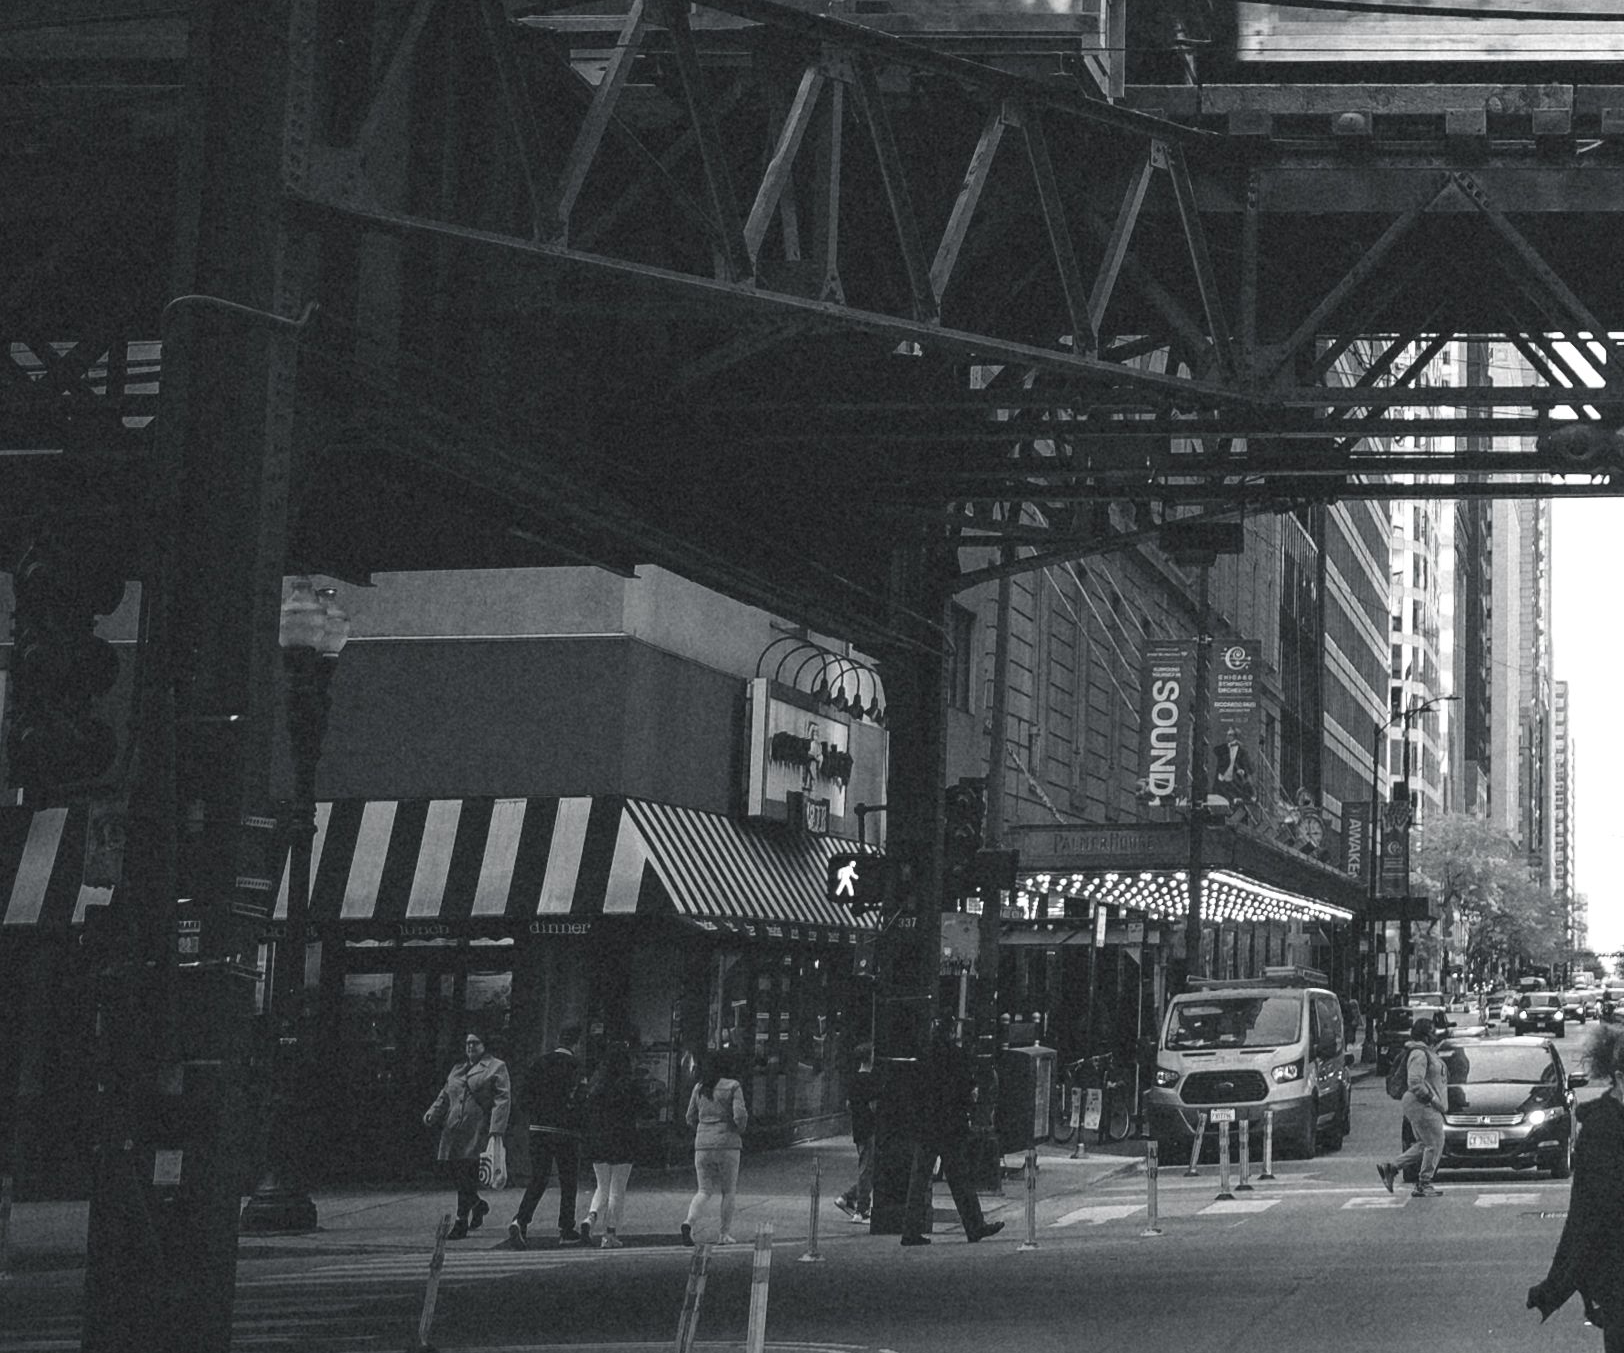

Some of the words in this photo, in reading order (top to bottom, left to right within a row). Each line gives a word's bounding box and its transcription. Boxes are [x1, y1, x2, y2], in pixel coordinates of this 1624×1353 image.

[1149, 680, 1180, 796] SOUND
[529, 920, 591, 935] dinner
[898, 917, 917, 928] 337
